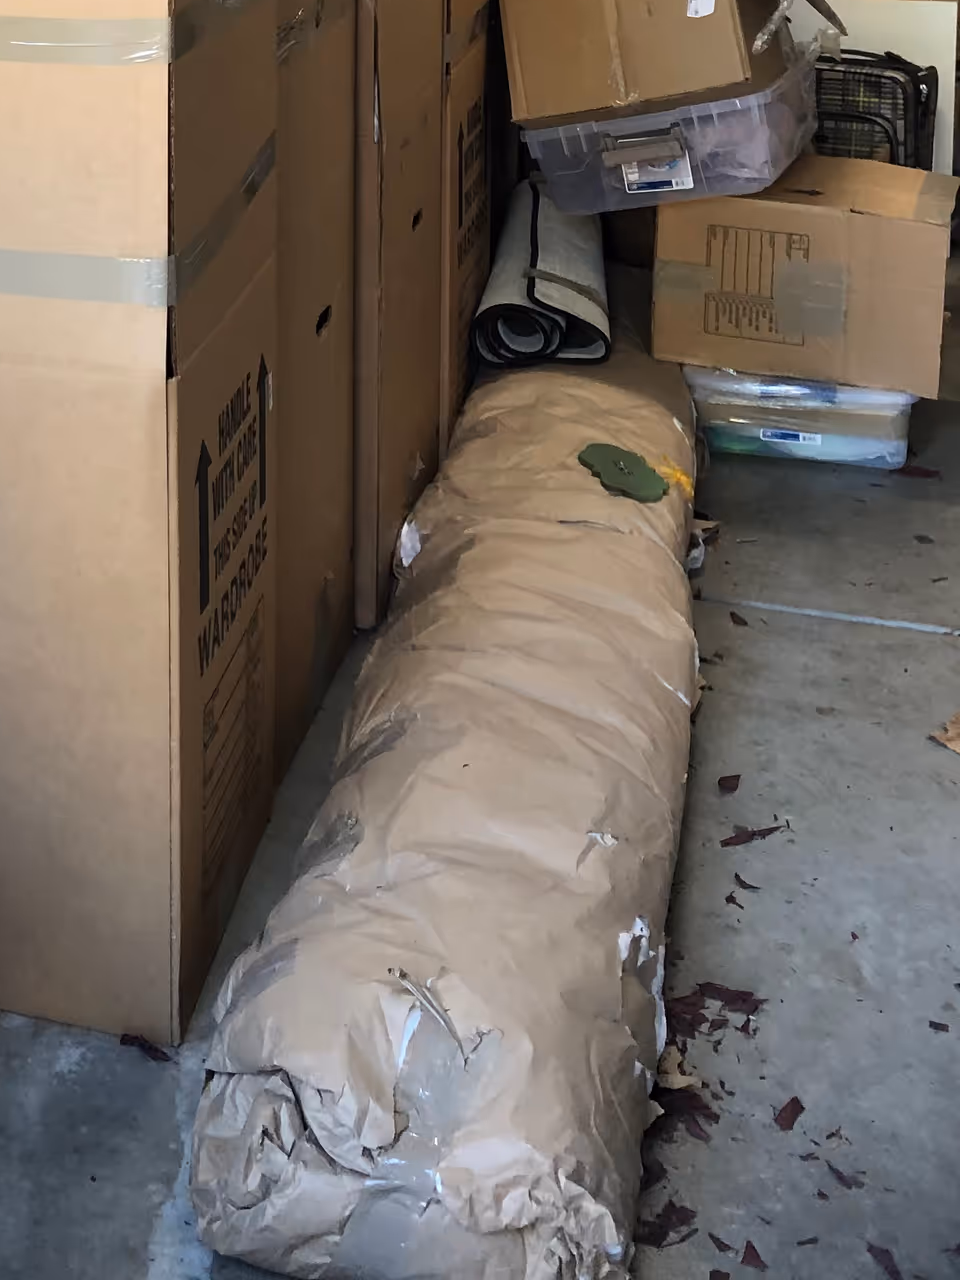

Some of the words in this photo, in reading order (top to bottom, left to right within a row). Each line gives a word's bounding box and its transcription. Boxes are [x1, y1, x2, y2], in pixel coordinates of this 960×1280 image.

[218, 372, 252, 457] HANDLE
[212, 450, 235, 520] WITH
[237, 415, 257, 481] CARE
[214, 528, 231, 582] THIS
[232, 498, 247, 550] SIDE
[249, 480, 258, 520] UP
[198, 515, 268, 677] WARDROBE
